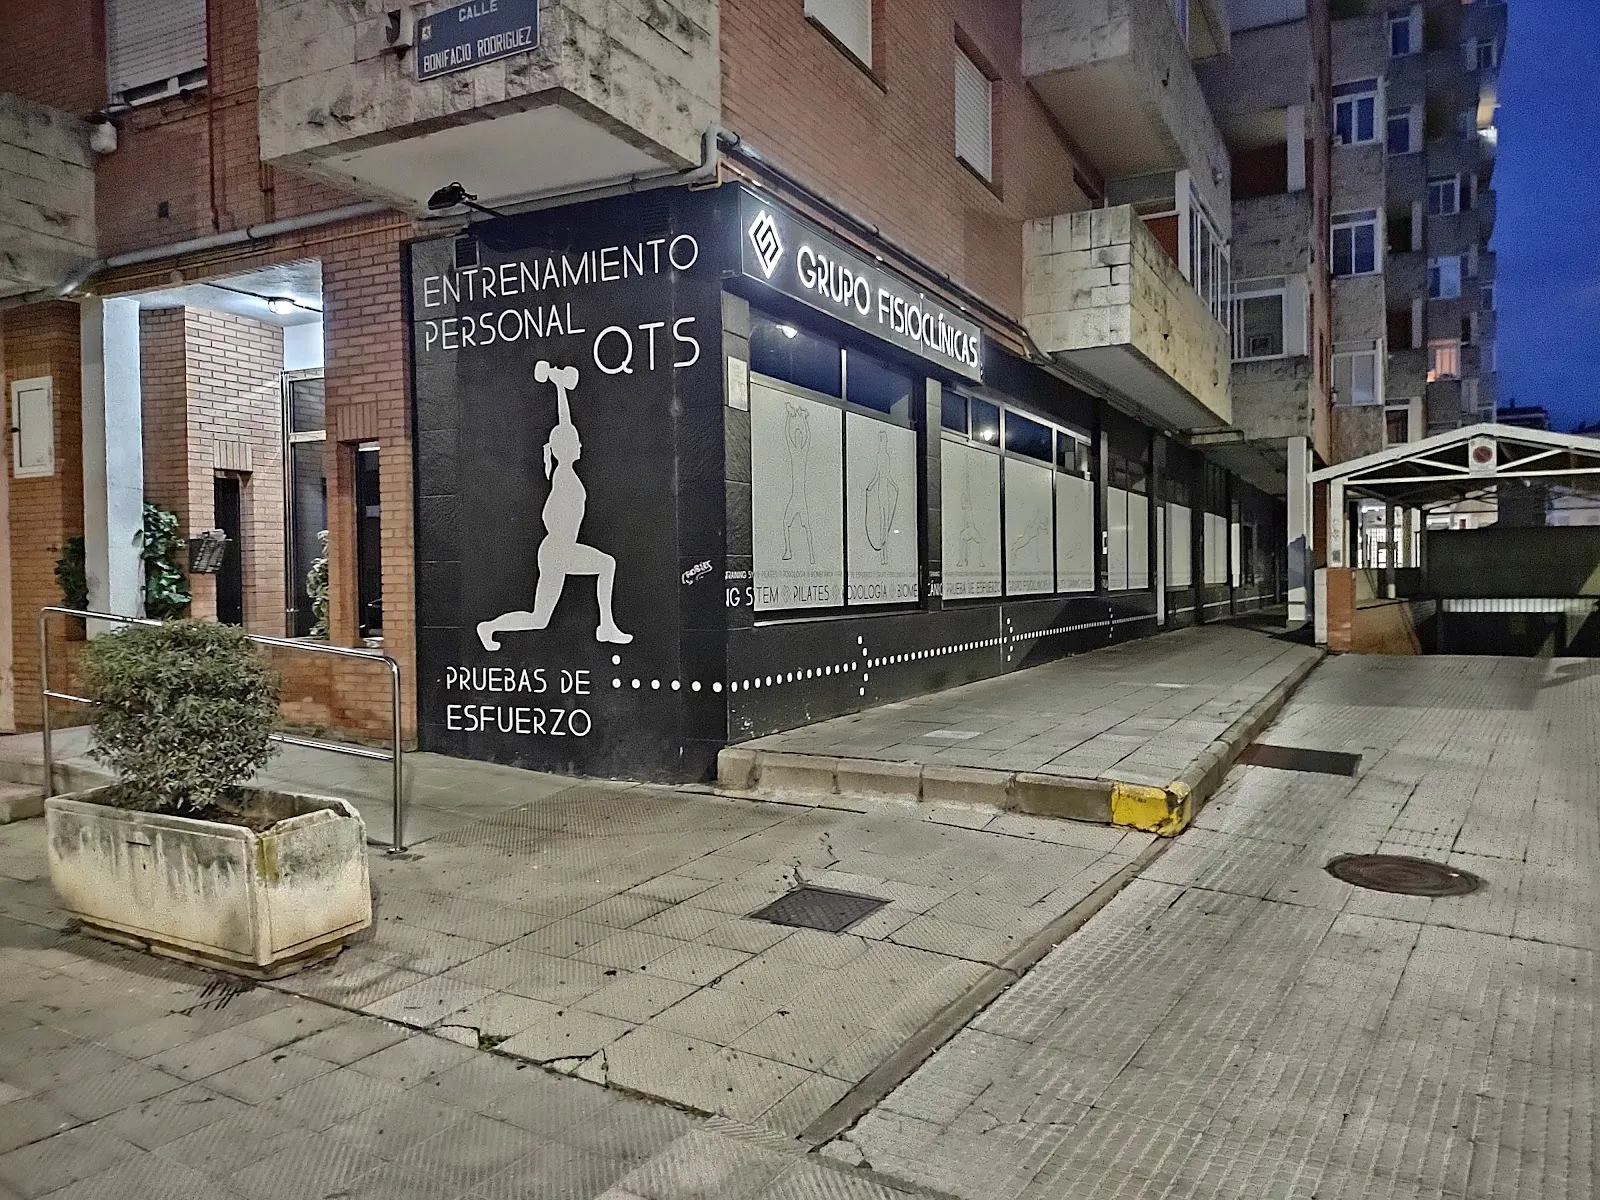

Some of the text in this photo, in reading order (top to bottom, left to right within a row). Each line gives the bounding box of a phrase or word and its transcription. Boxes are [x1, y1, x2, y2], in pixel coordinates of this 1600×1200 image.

[459, 0, 498, 21] CALLE
[423, 26, 532, 73] BONIFACIO RODRIGUEZ
[423, 234, 699, 308] ENTRENAMIENTO
[796, 245, 871, 316] GRUPO
[424, 302, 586, 352] PERSONAL
[593, 316, 701, 375] QTS
[793, 585, 830, 602] PILATES
[446, 666, 591, 695] PRUEBAS DE
[446, 704, 592, 737] ESFUERZO
